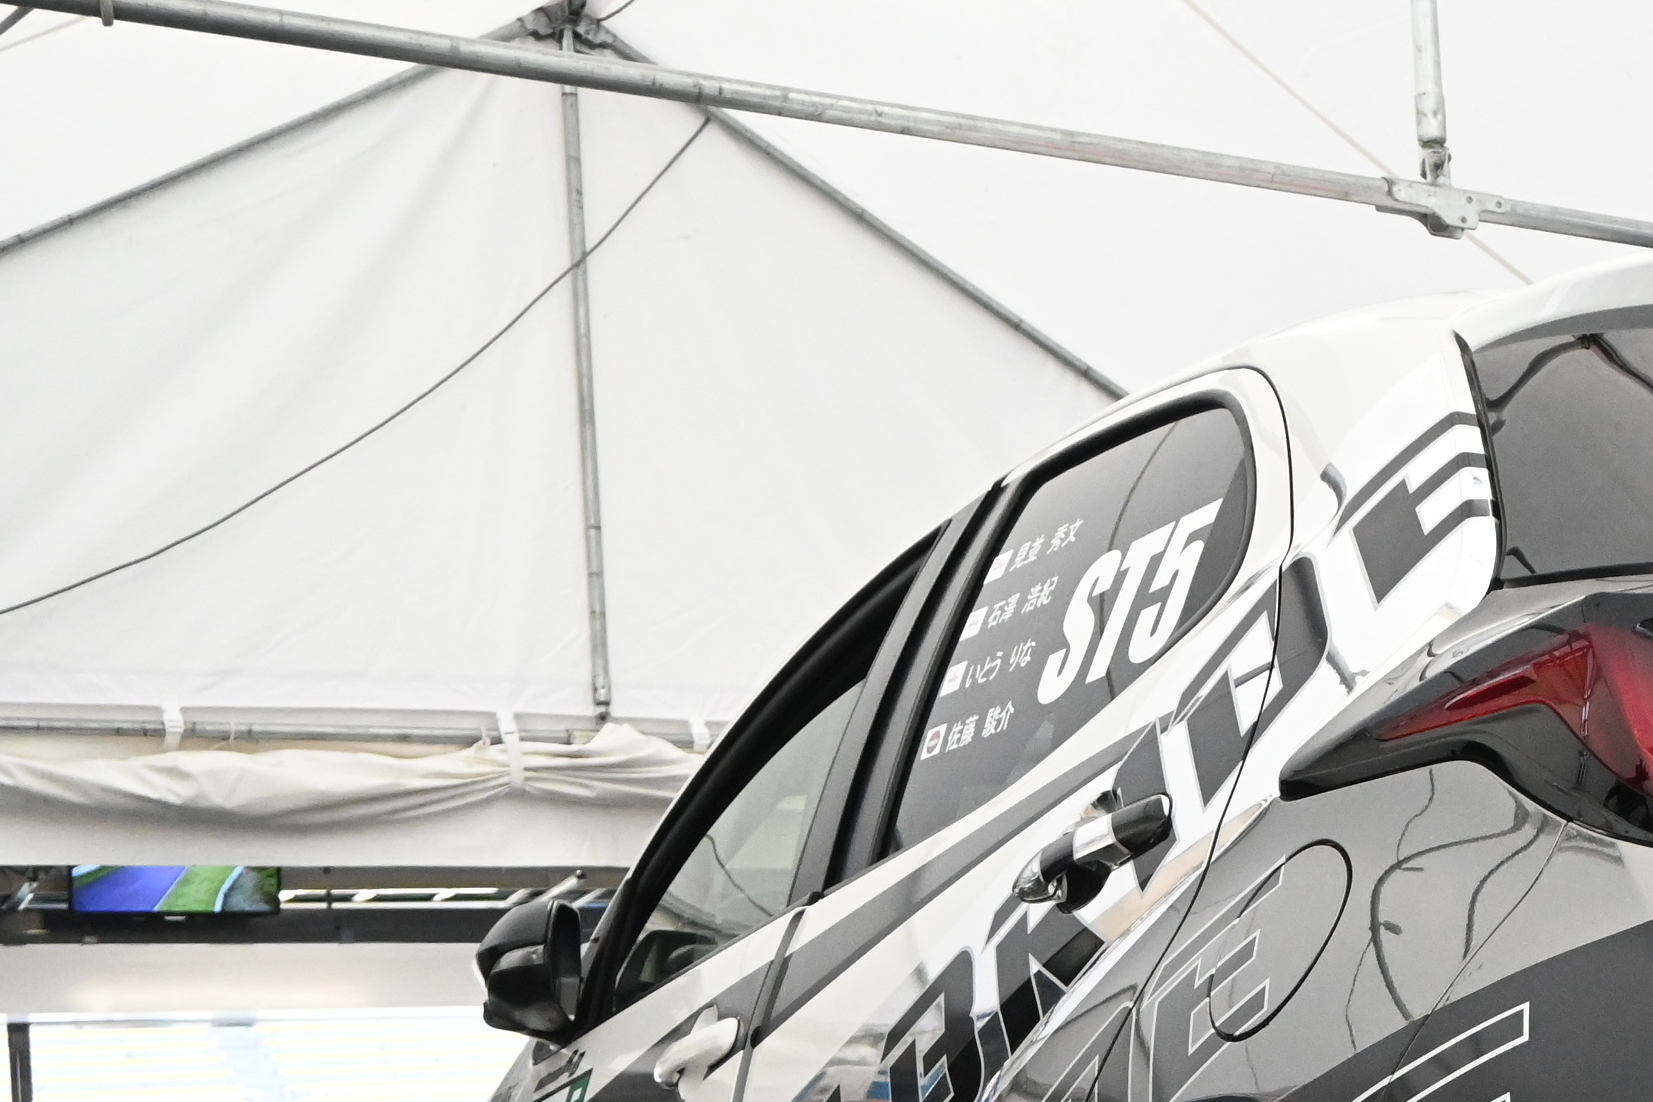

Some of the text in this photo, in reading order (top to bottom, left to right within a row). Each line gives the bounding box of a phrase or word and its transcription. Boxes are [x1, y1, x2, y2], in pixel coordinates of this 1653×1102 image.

[1047, 518, 1084, 555] 秀文
[1037, 498, 1223, 705] ST5
[965, 639, 1036, 689] いとう りな
[945, 714, 979, 753] 佐藤
